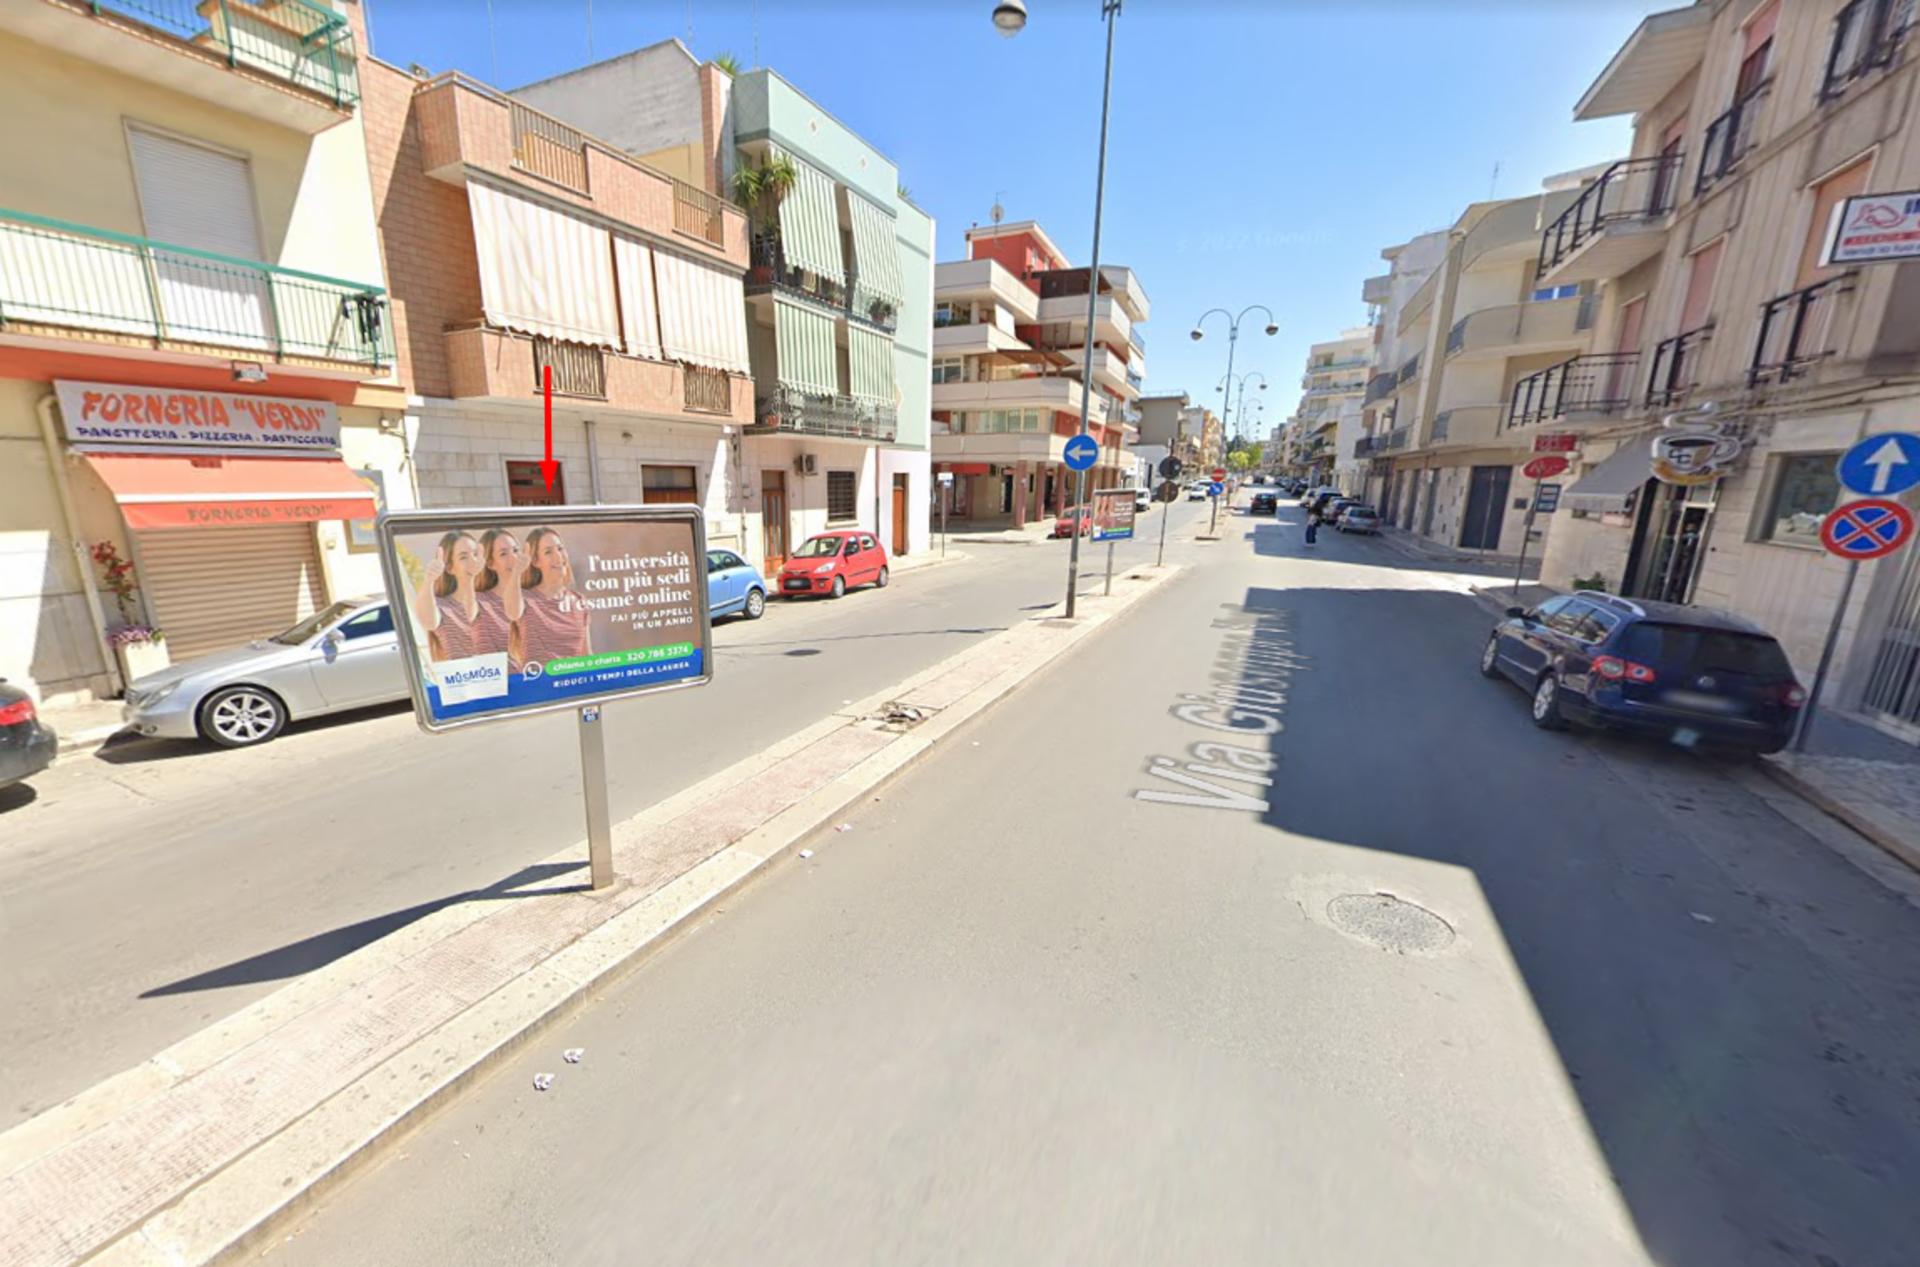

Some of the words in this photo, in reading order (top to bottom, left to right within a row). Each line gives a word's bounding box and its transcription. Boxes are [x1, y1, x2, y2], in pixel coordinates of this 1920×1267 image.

[82, 390, 230, 428] FORNERIA
[233, 397, 326, 432] "VERDI"
[76, 427, 178, 439] PANETTERIA
[188, 430, 252, 442] PIZZERIA
[262, 433, 337, 445] PASTICCERIA
[187, 506, 271, 521] FORNERIA
[589, 552, 689, 572] l'università
[585, 577, 619, 591] con
[623, 571, 652, 593] più
[656, 567, 691, 585] sedi
[558, 593, 634, 613] d'esame
[638, 587, 692, 605] online
[611, 613, 628, 623] FAI
[631, 609, 650, 621] PIÙ
[652, 606, 693, 619] APPELLI
[633, 622, 644, 630] IN
[647, 619, 662, 629] UN
[665, 615, 693, 626] ANNO
[553, 677, 588, 688] RIDUCI
[597, 670, 624, 681] TEMPI
[626, 667, 655, 678] DELLA
[656, 660, 690, 673] LAUREA
